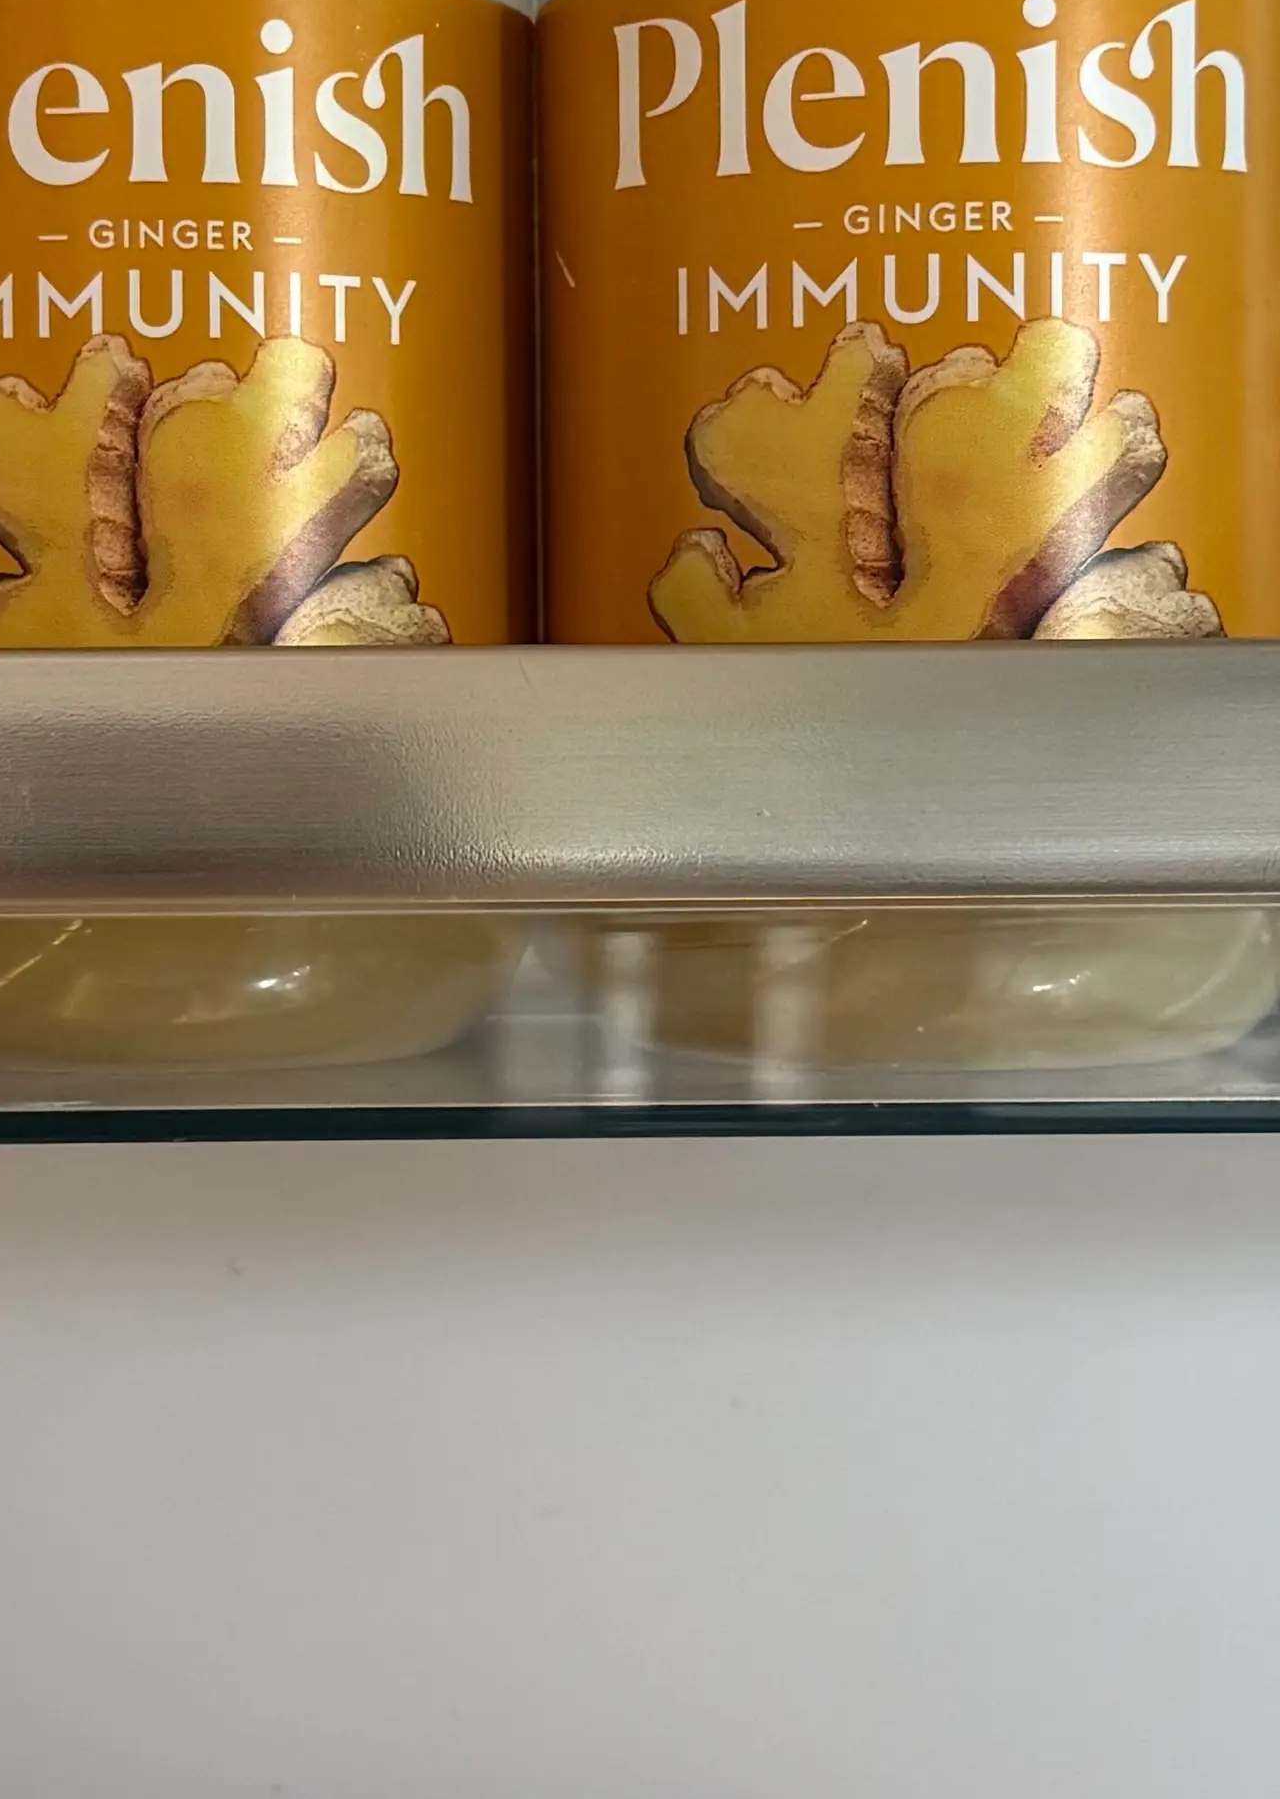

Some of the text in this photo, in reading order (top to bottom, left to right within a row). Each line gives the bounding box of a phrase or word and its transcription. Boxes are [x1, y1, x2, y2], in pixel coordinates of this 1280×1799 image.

[88, 220, 254, 250] GINGER
[843, 202, 1014, 235] GINGER
[675, 252, 1188, 335] IMMUNITY
